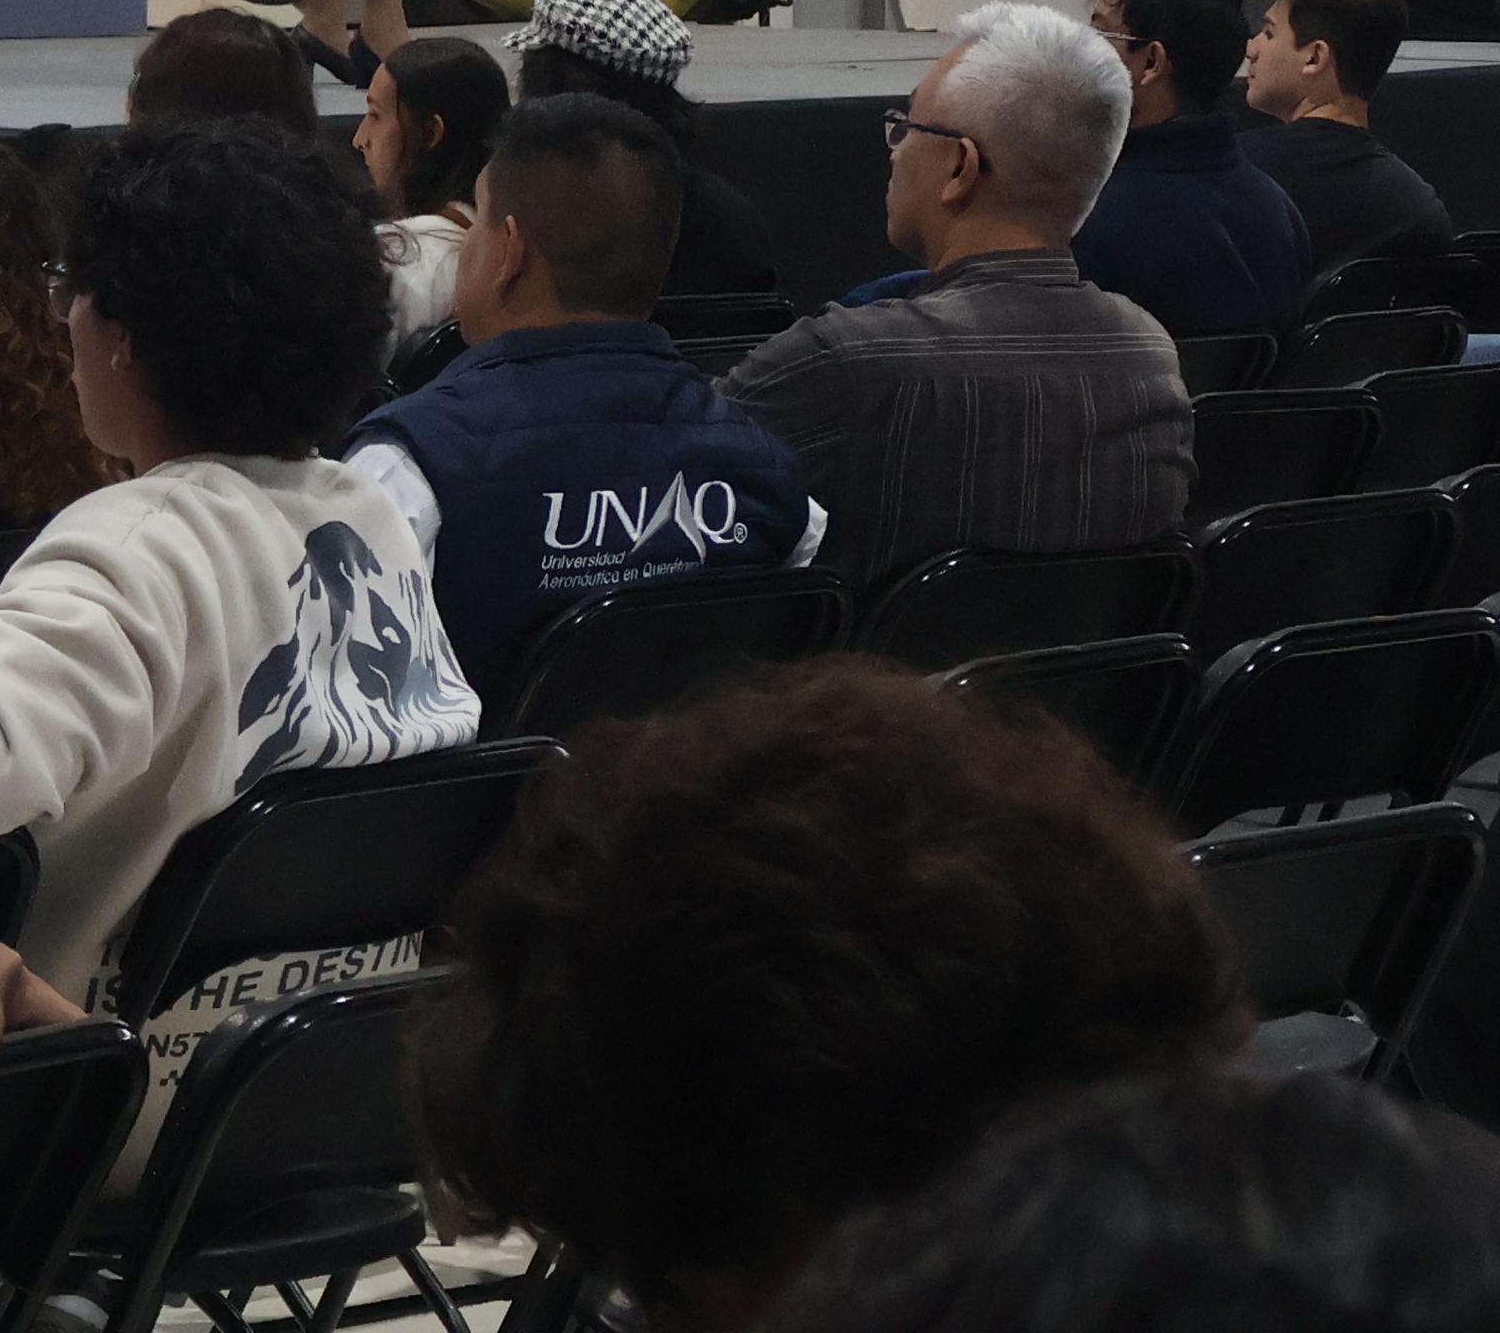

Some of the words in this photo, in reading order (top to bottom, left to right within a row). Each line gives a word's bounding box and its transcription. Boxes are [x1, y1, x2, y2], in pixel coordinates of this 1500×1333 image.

[542, 469, 737, 566] UNAQ
[538, 567, 620, 590] Aeronáutica
[622, 568, 639, 582] en
[541, 551, 627, 571] Universidad
[277, 931, 425, 996] DESTIN
